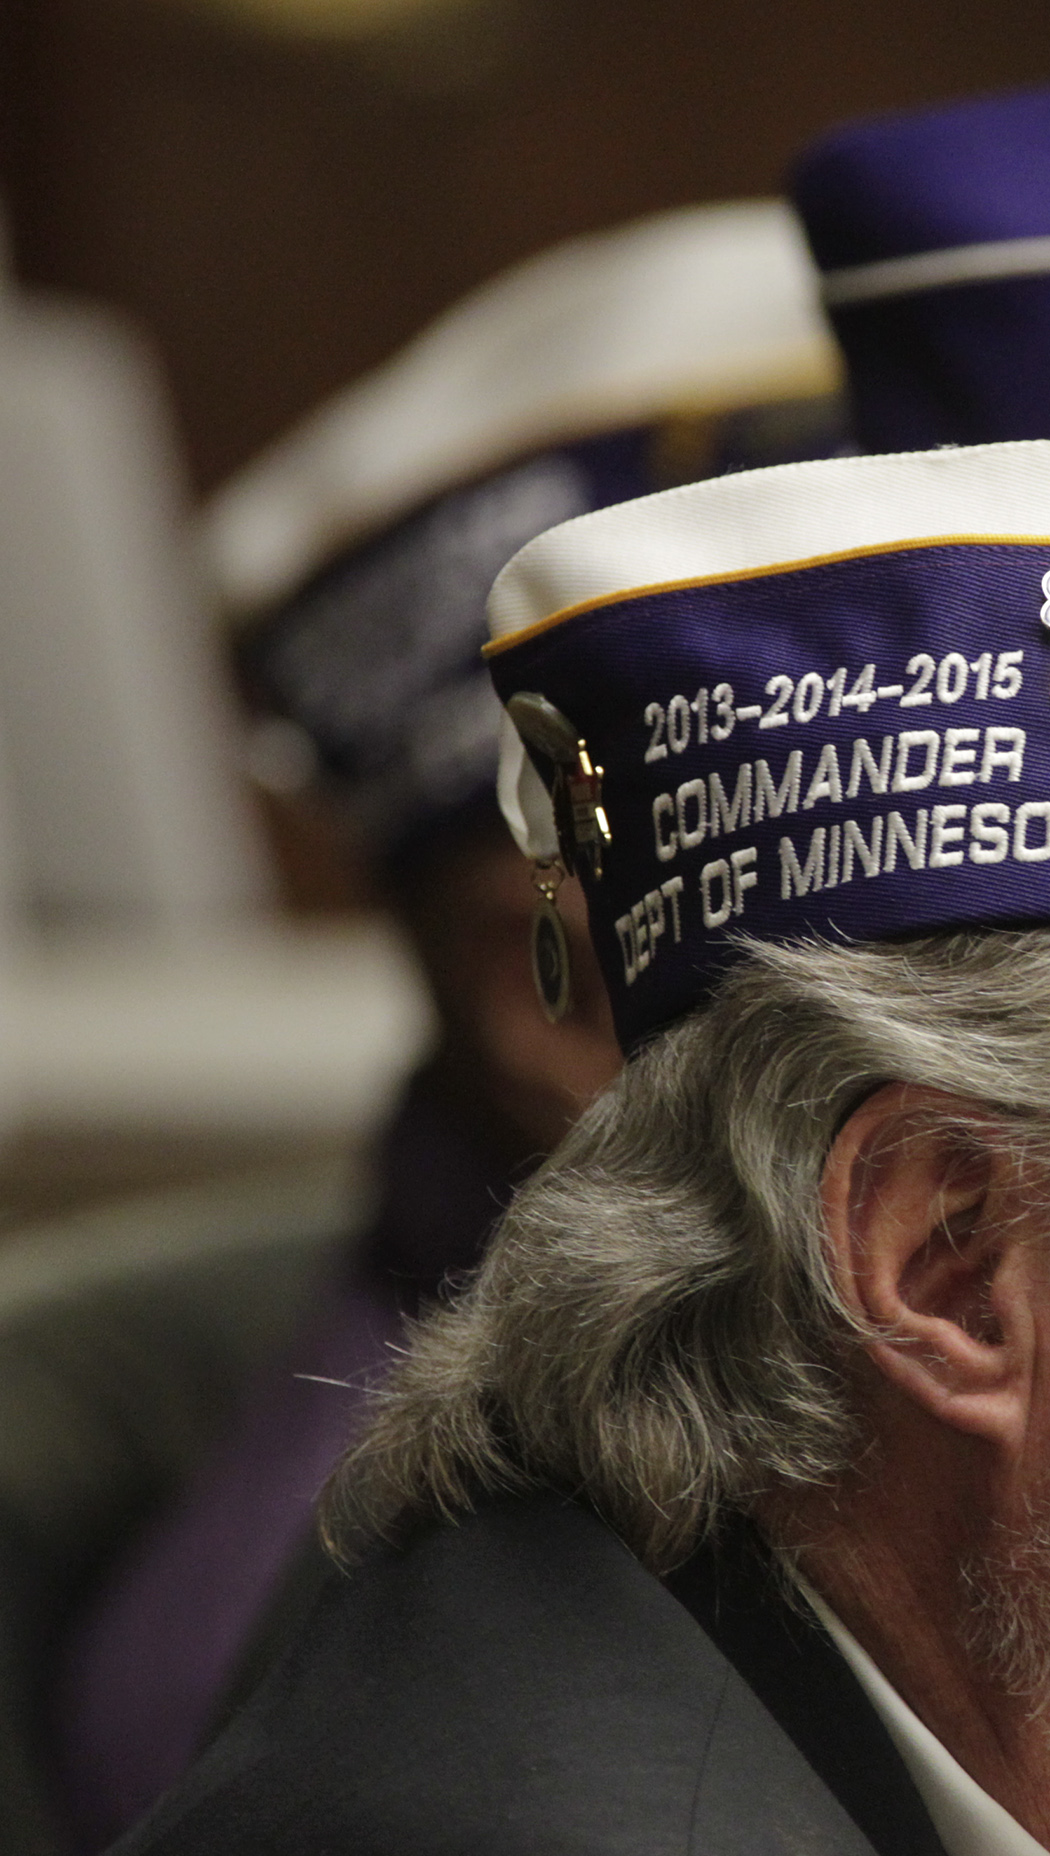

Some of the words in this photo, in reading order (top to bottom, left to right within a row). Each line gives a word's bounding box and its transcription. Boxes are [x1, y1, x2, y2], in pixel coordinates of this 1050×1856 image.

[644, 650, 1024, 763] 2013-2014-2015
[652, 727, 1026, 862] COMMANDER
[615, 876, 683, 986] DEPT
[701, 847, 757, 928] OF
